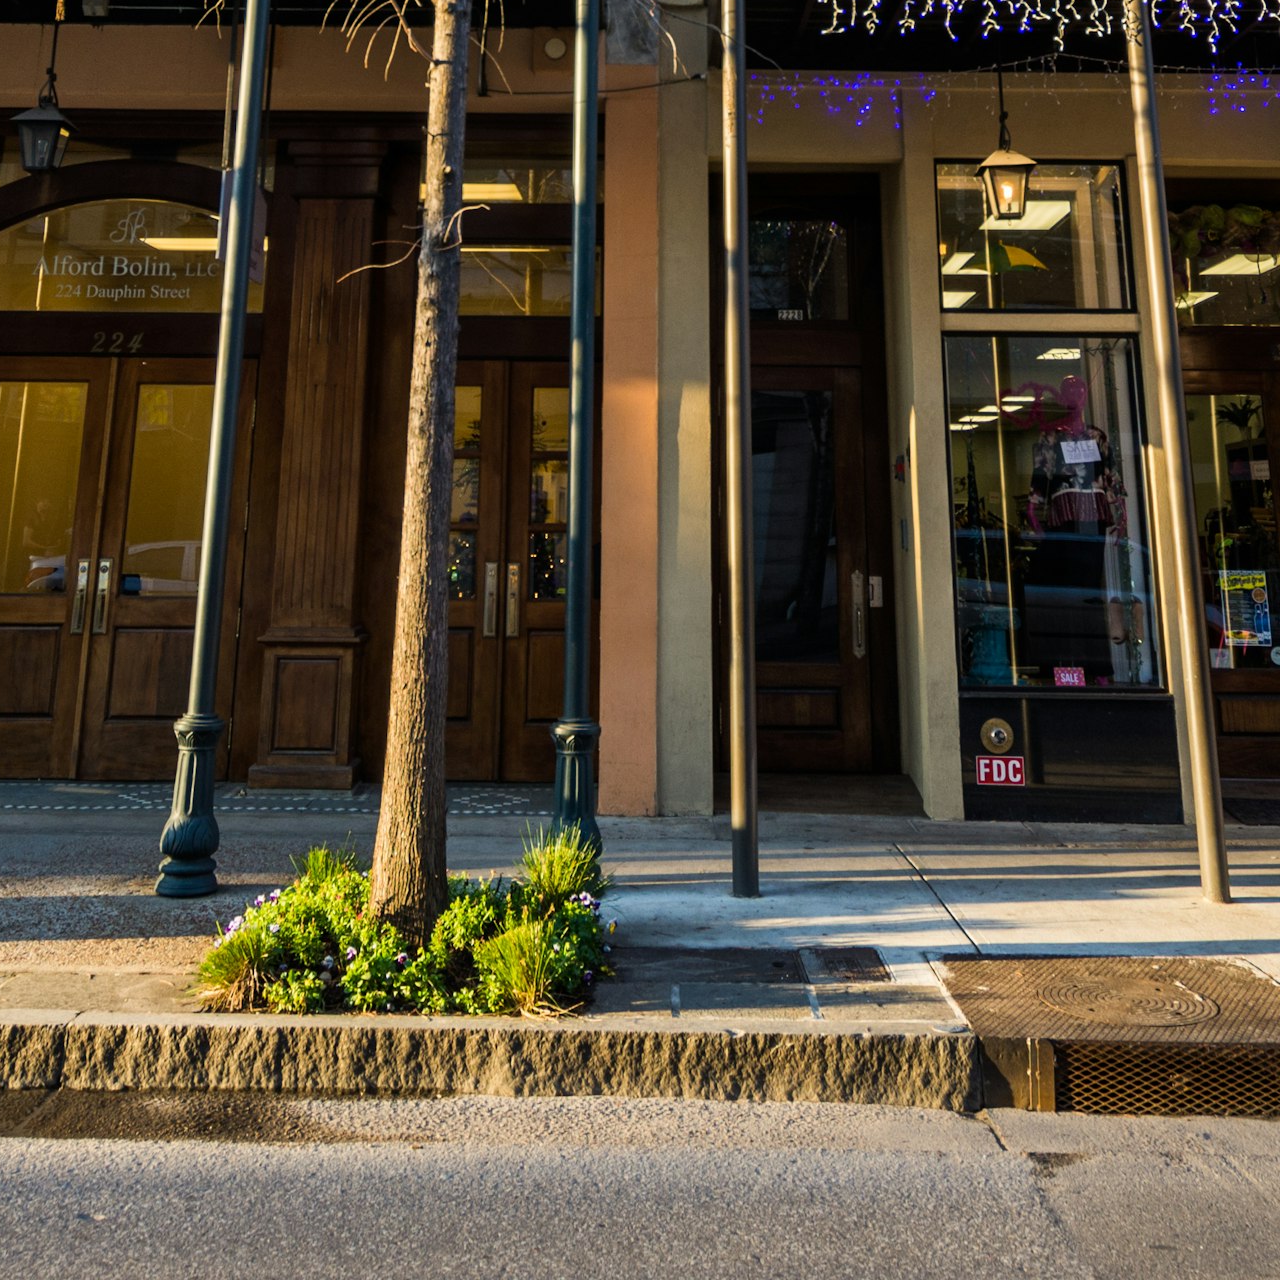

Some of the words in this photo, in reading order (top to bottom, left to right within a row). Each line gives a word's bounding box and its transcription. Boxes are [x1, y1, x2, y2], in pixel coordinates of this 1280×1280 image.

[32, 255, 104, 276] Alford
[112, 255, 177, 280] Bolin,
[185, 262, 219, 277] LLC
[55, 284, 82, 299] 224
[86, 284, 146, 302] Dauphin
[150, 284, 191, 299] Street
[91, 331, 145, 353] 224
[1060, 672, 1079, 683] SALE
[979, 759, 1022, 783] FDC
